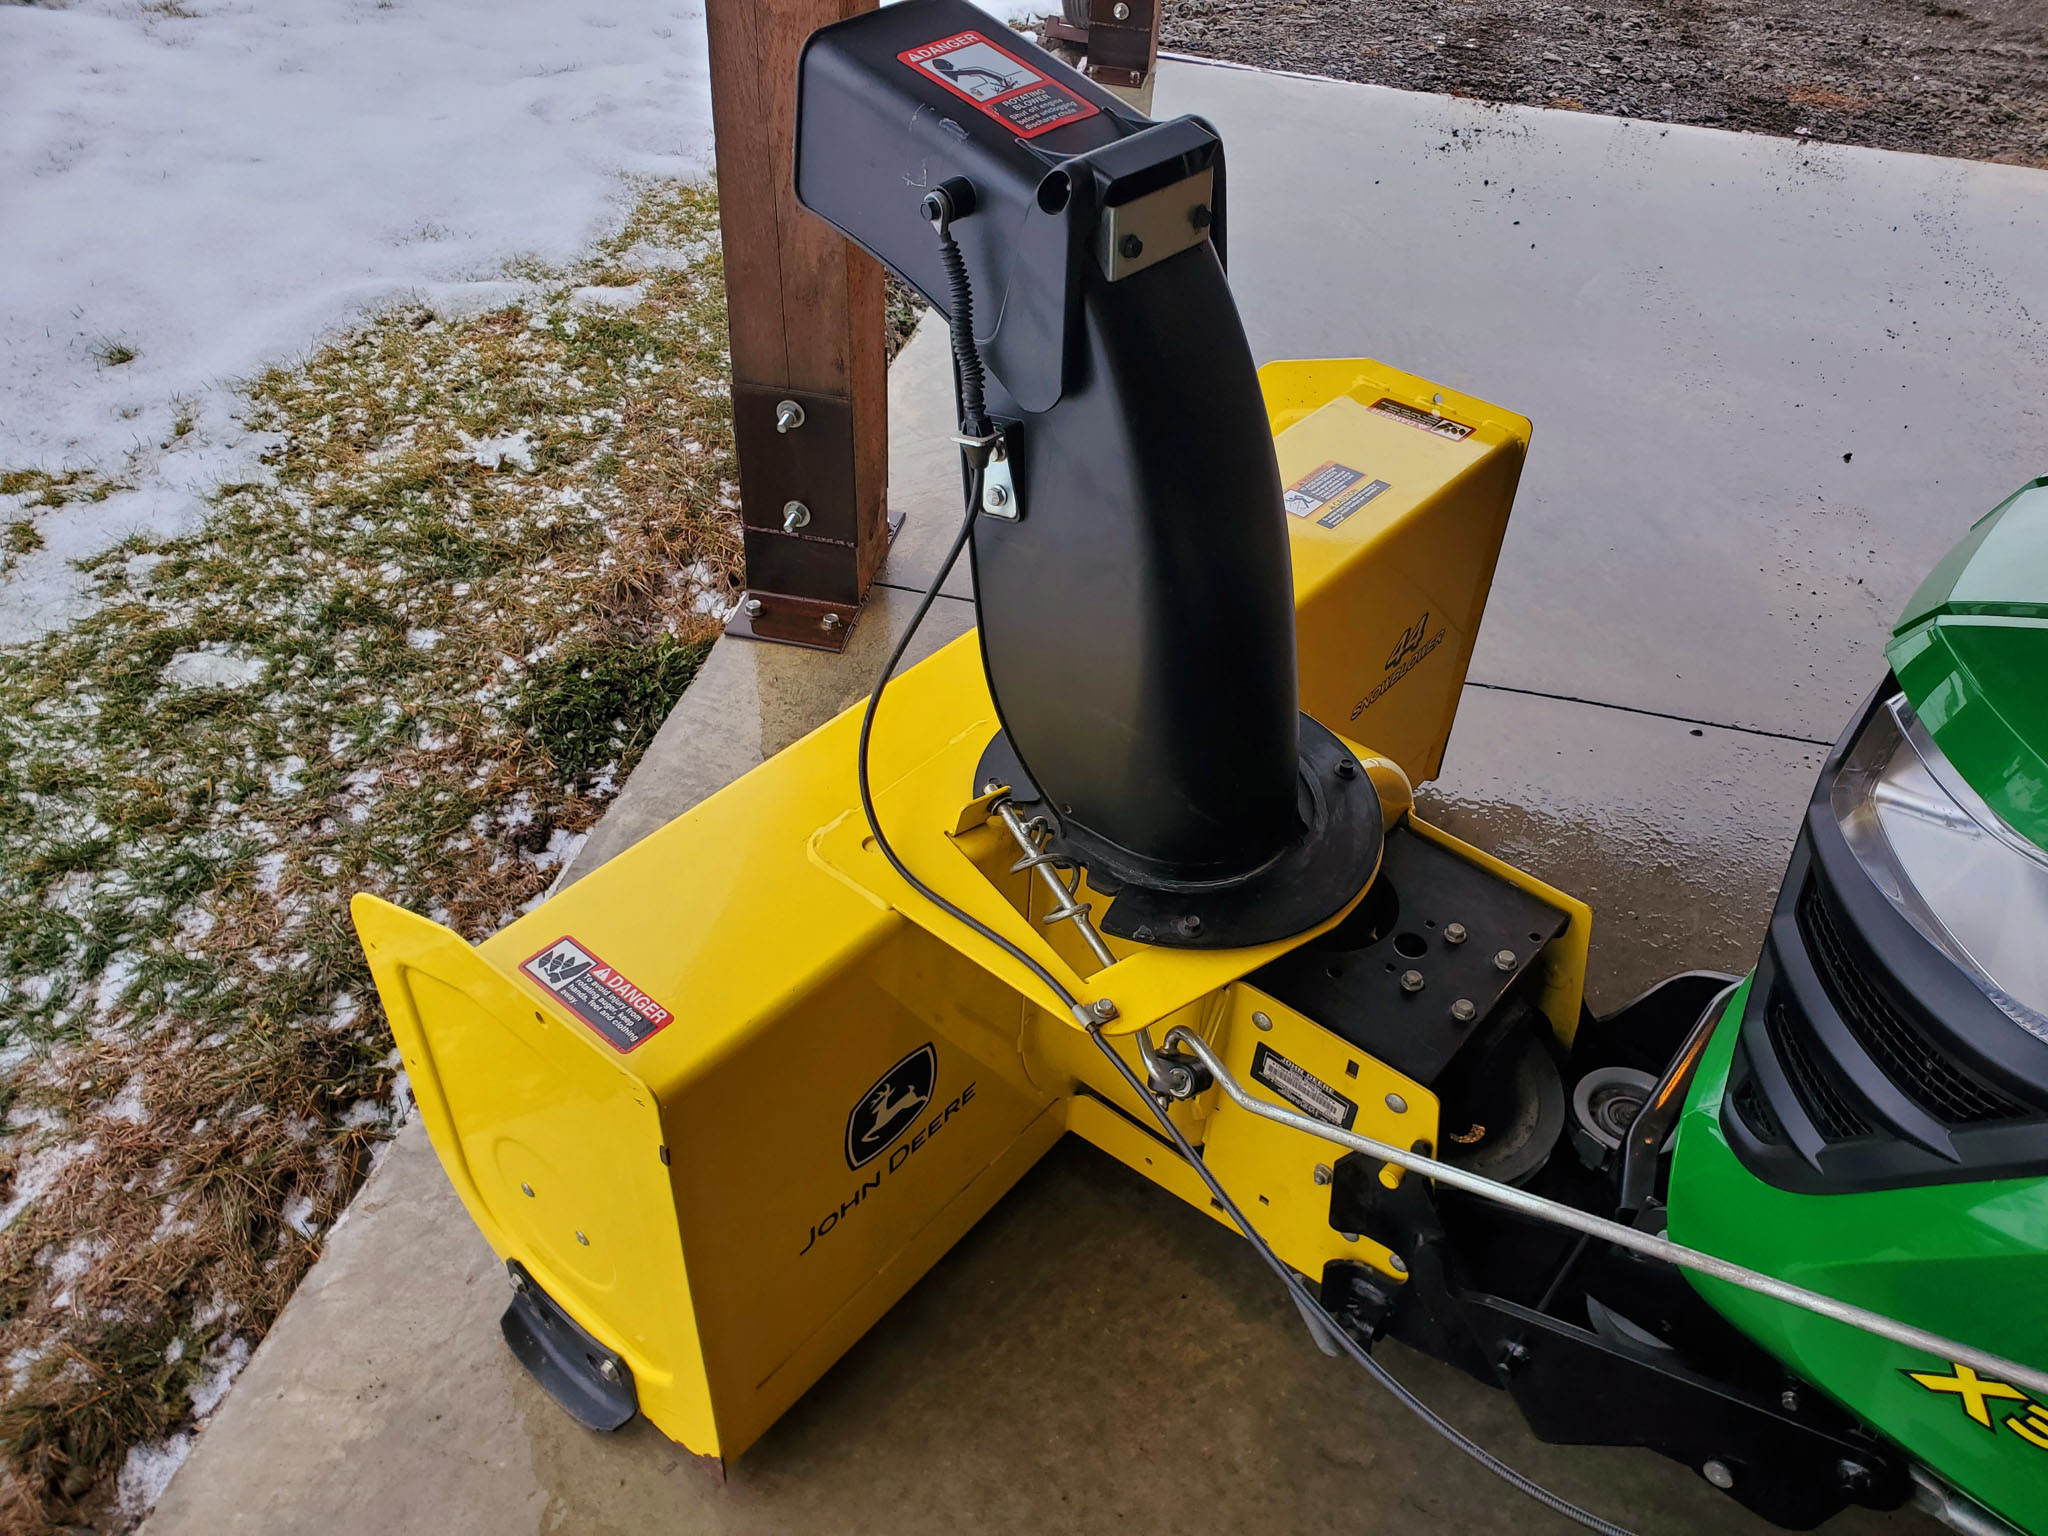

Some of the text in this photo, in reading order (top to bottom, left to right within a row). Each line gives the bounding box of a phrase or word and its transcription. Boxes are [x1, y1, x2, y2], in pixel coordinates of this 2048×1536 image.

[917, 33, 979, 59] DANGER
[1002, 88, 1046, 107] ROTATING
[1009, 98, 1063, 120] Shut off engine
[1012, 94, 1051, 110] BLOWER
[1017, 101, 1077, 125] before unclogging
[1026, 114, 1057, 130] discharge
[1371, 408, 1415, 425] DANGER
[1333, 489, 1358, 508] CAUTION
[1385, 611, 1429, 671] 44
[1350, 628, 1446, 720] SNOWBLOWER
[560, 990, 578, 1005] away.
[576, 979, 635, 1026] rotating auger, keep
[583, 974, 642, 1021] To avoid injury from
[607, 976, 667, 1023] DANGER
[568, 984, 638, 1042] hands, feet and clothing
[1281, 1058, 1335, 1095] JOHN DEERE
[799, 1081, 976, 1256] JOHN DEERE
